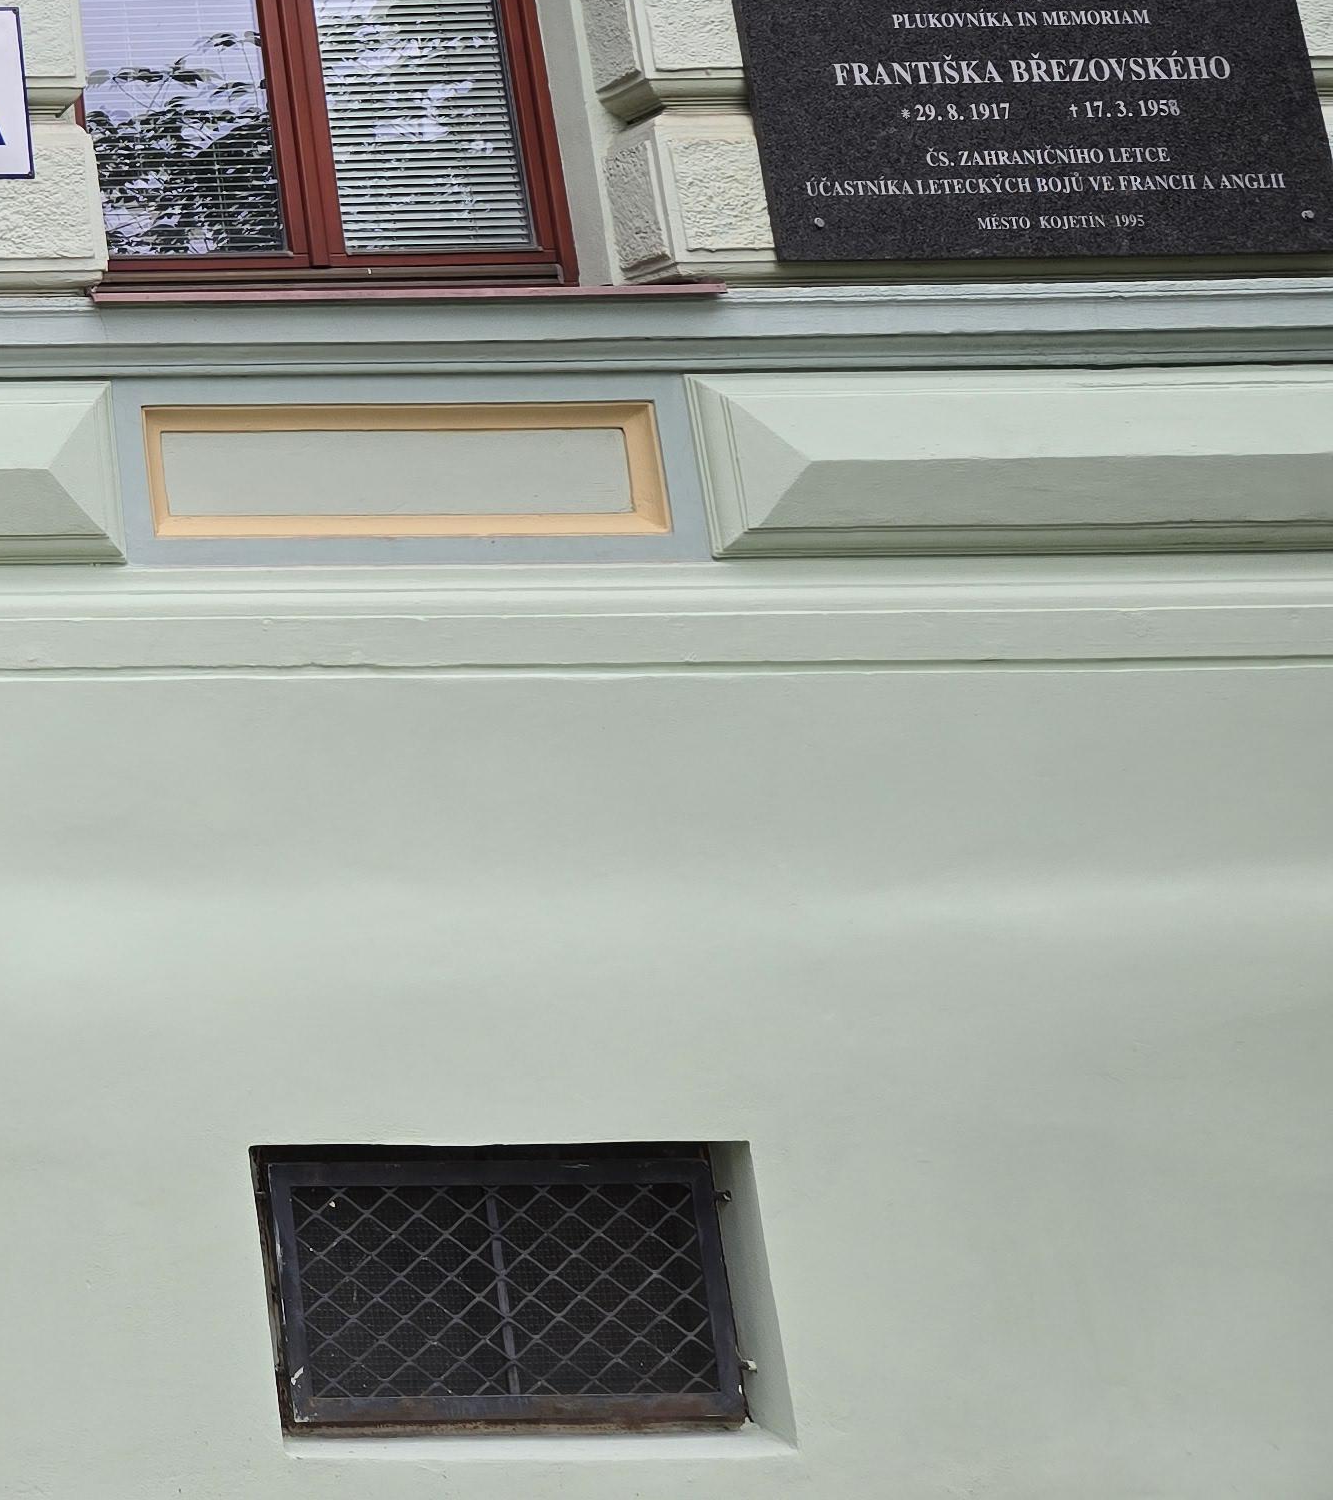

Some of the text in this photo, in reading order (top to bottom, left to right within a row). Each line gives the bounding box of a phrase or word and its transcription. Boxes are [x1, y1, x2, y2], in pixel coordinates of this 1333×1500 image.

[892, 8, 1151, 29] PLUKOVNÍKA IN MEMORIAM
[832, 50, 1231, 86] FRANTIŠKA BŘEZOVSKÉHO
[925, 144, 1171, 167] ČS. ZAHRANIČNÍHO LETCE
[805, 171, 1286, 197] ÚČASTNÍKA LETECKÝCH BOJŮ VE FRANCII A ANGLII
[1039, 211, 1106, 230] KOJETÍN
[1114, 213, 1145, 228] 1995
